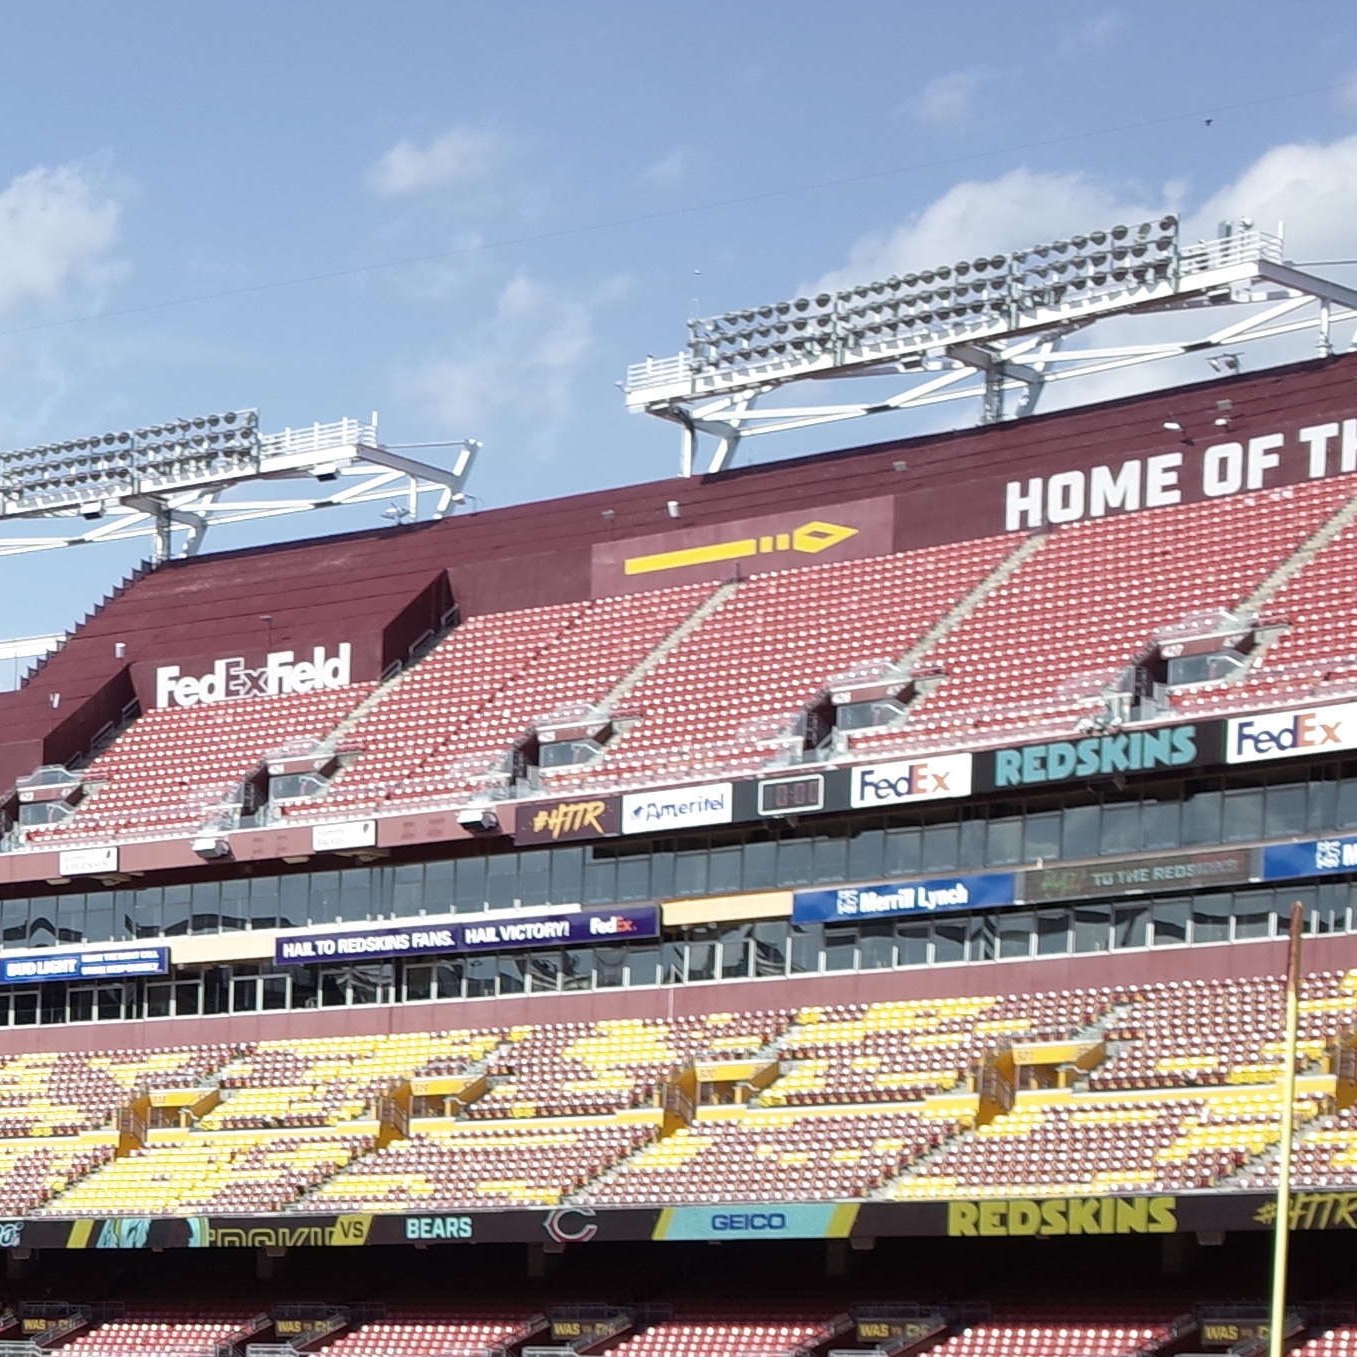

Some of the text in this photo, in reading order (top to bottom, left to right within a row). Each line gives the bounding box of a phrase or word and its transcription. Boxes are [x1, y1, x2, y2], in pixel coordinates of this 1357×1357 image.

[1004, 432, 1284, 531] HOME OF
[156, 642, 352, 709] FedExField
[1236, 712, 1344, 756] FedEx
[994, 725, 1197, 788] REDSKINS
[858, 763, 950, 802] FedEx
[532, 801, 607, 839] #HTTR
[646, 794, 725, 824] Ameritel
[1092, 872, 1114, 887] TO
[1115, 868, 1150, 884] THE
[859, 884, 968, 913] Merrill Lynch
[464, 921, 570, 945] HAIL VICTORY!
[589, 915, 634, 935] FedEx
[282, 931, 455, 958] HAIL TO REDSKINS FANS.
[6, 961, 36, 977] BUD
[37, 958, 78, 975] LIGHT
[405, 1217, 473, 1239] BEARS
[712, 1213, 786, 1231] GEICO
[947, 1197, 1178, 1237] REDSKINS
[340, 1220, 364, 1240] VS
[24, 1319, 46, 1331] WAS
[277, 1320, 302, 1332] WAS
[554, 1323, 581, 1335] WAS
[860, 1324, 888, 1337] WAS
[1205, 1326, 1239, 1340] WAS
